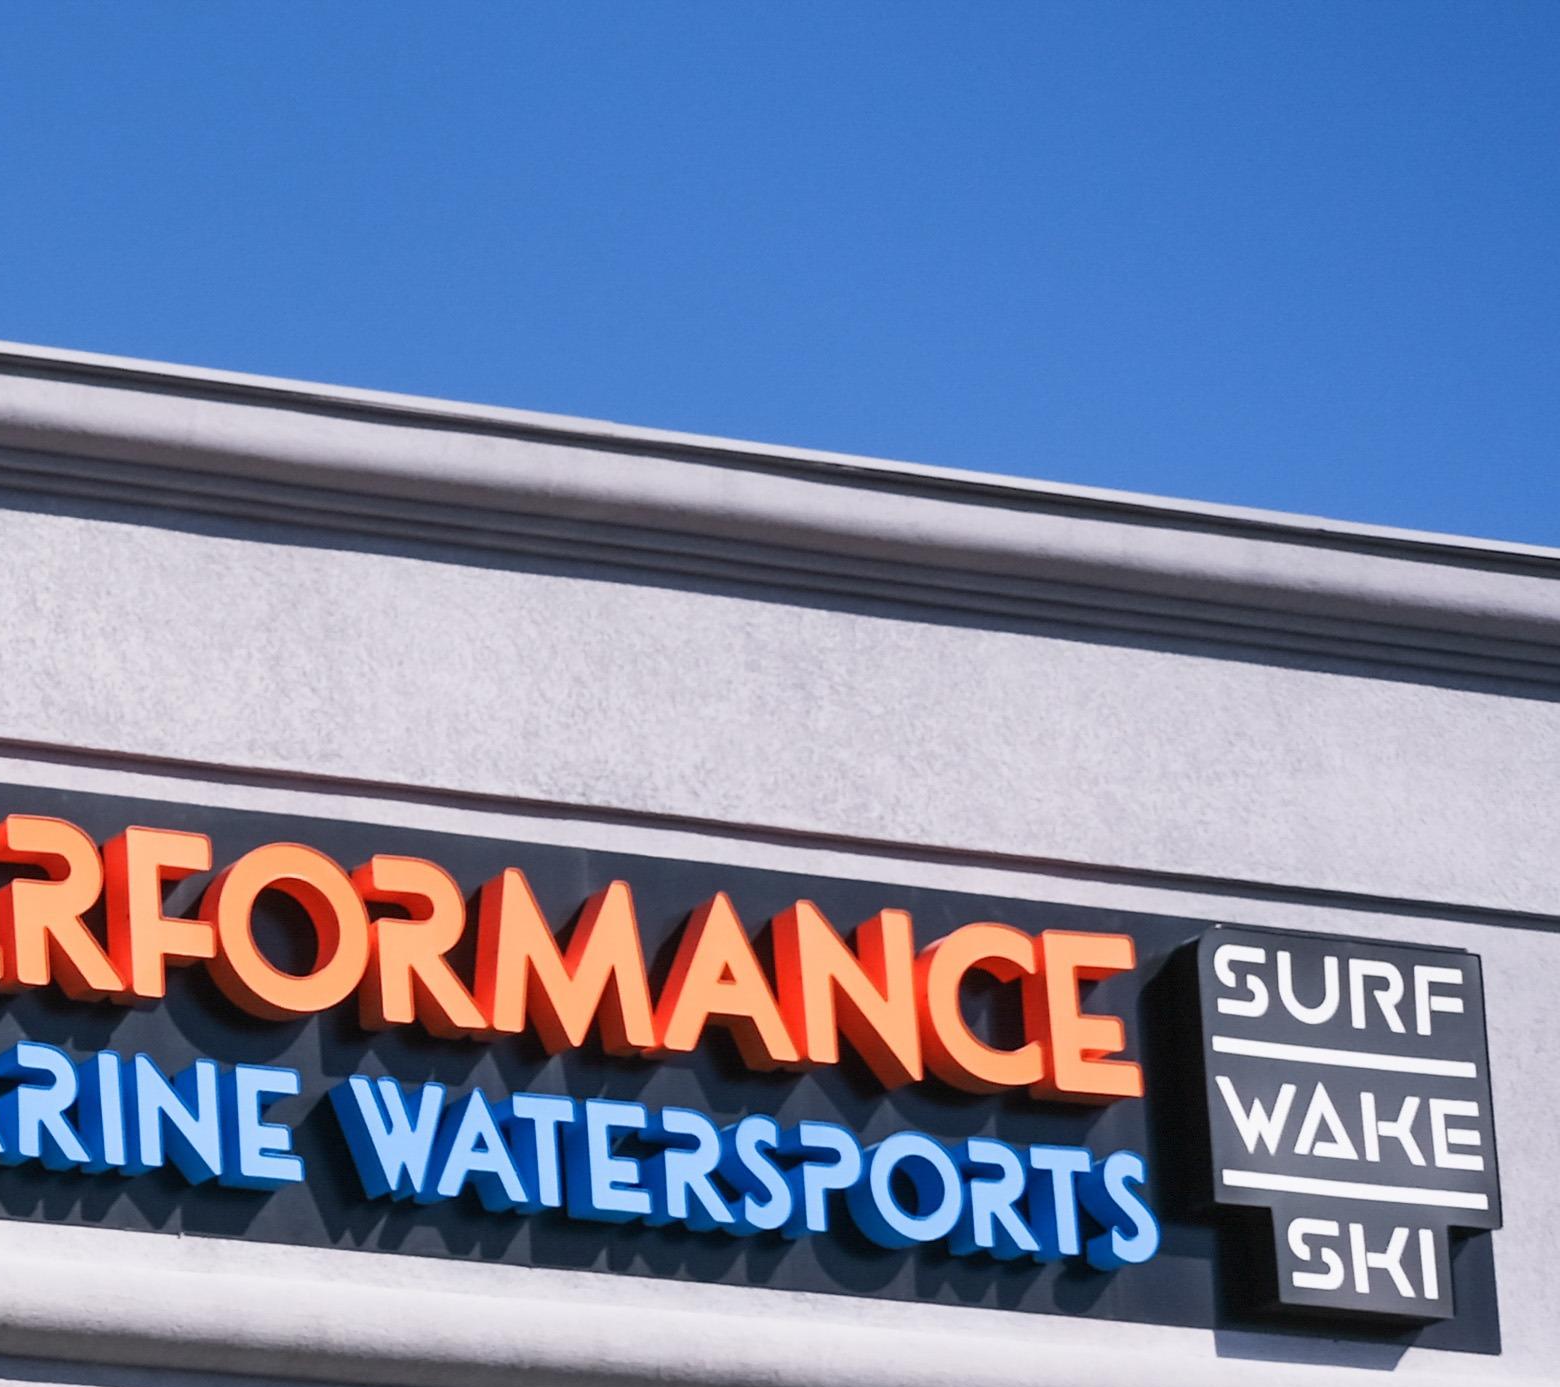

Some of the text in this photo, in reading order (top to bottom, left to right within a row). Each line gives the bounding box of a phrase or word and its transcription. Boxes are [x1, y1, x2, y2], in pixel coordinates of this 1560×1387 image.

[1213, 943, 1464, 1036] SURF
[1215, 1075, 1485, 1171] WAKE
[330, 1075, 1160, 1271] WATERSPORTS
[1287, 1216, 1439, 1300] SKI
